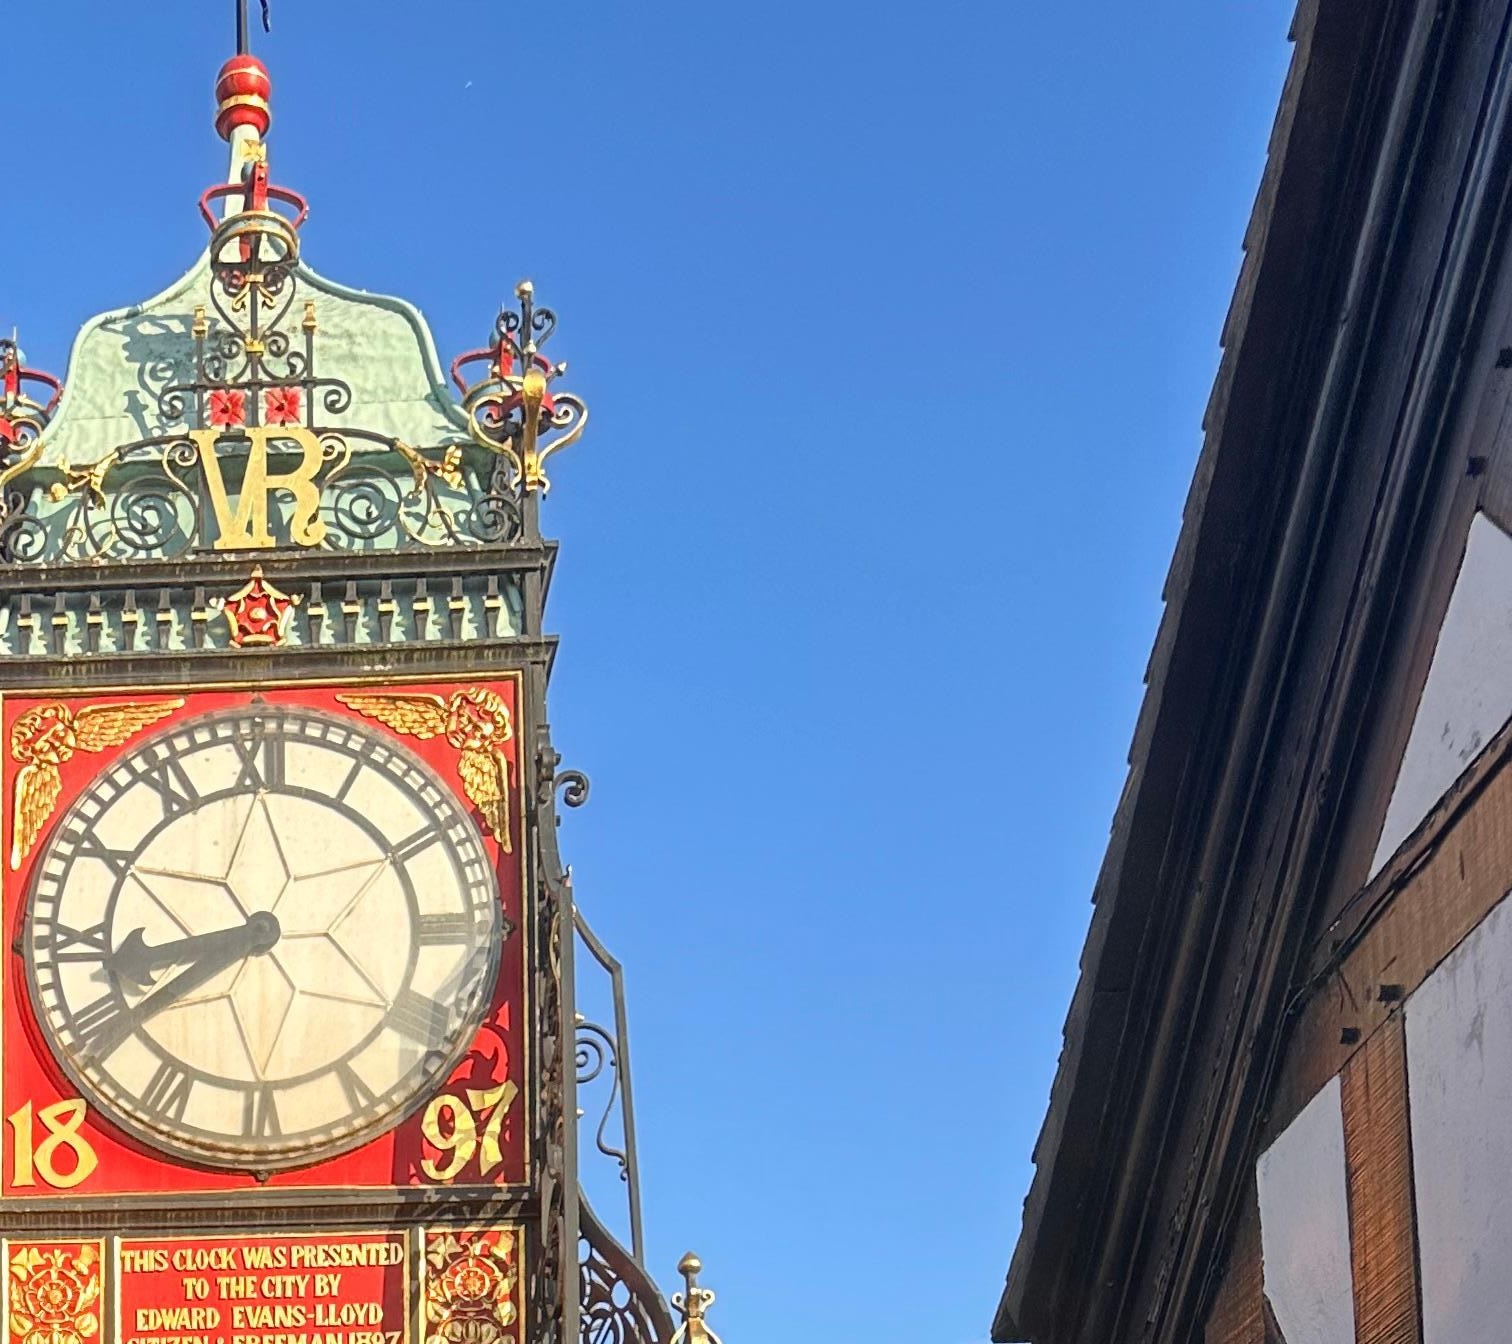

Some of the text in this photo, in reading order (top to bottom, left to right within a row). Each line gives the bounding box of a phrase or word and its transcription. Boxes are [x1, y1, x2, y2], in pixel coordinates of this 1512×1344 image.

[232, 739, 285, 788] XII
[419, 913, 468, 945] III
[7, 1080, 519, 1188] 18 97
[121, 1242, 404, 1273] THIS CLOCK WAS PRESENTED
[183, 1274, 341, 1300] TO THE CITY BY
[135, 1302, 384, 1331] EDWARD EVANS-LLOYD
